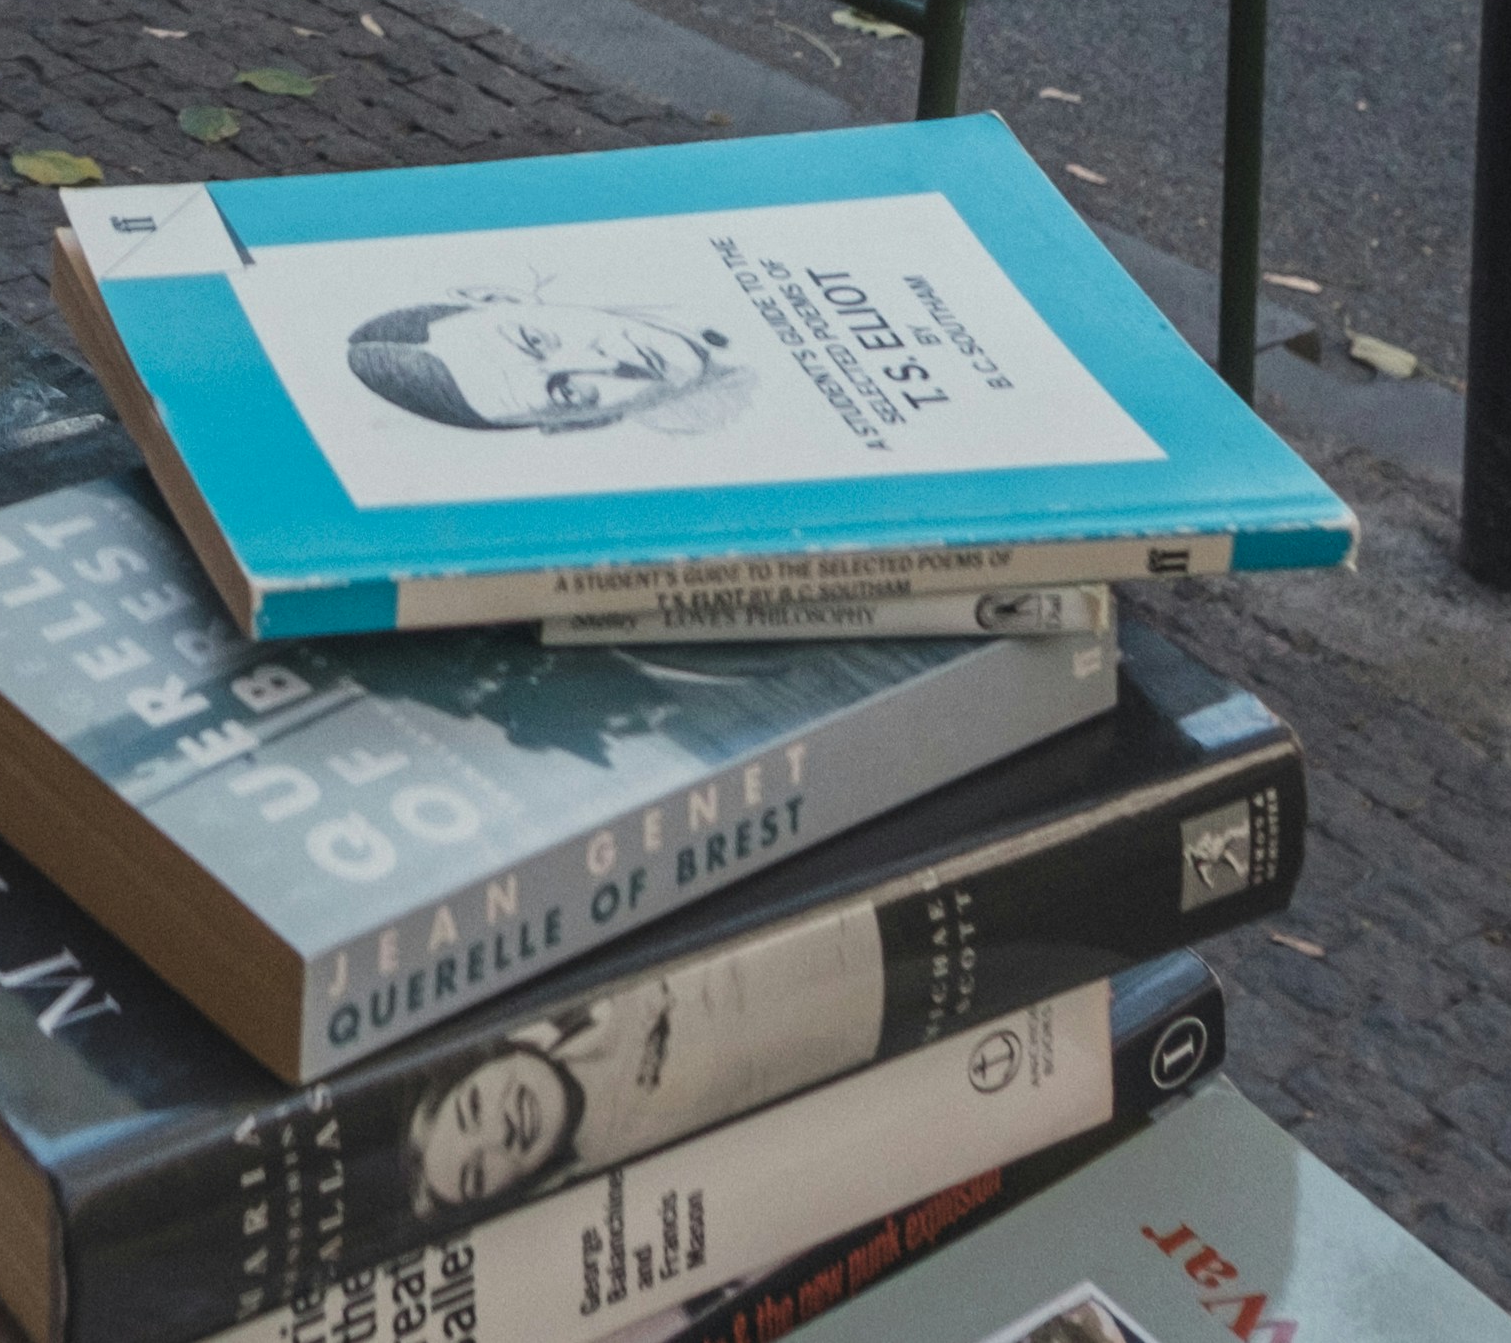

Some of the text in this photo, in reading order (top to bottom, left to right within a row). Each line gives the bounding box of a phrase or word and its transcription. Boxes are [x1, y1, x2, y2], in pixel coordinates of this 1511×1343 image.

[709, 236, 804, 347] GUIDE TO THE
[806, 267, 906, 352] ELIOT
[907, 323, 942, 347] BY
[759, 257, 907, 426] SELECTED POEMS OF
[917, 550, 984, 573] POEMS
[326, 741, 811, 1000] JEAN GENET
[326, 795, 807, 1049] QUERELLE OF BREST
[578, 1226, 603, 1315] George
[633, 1244, 654, 1291] and
